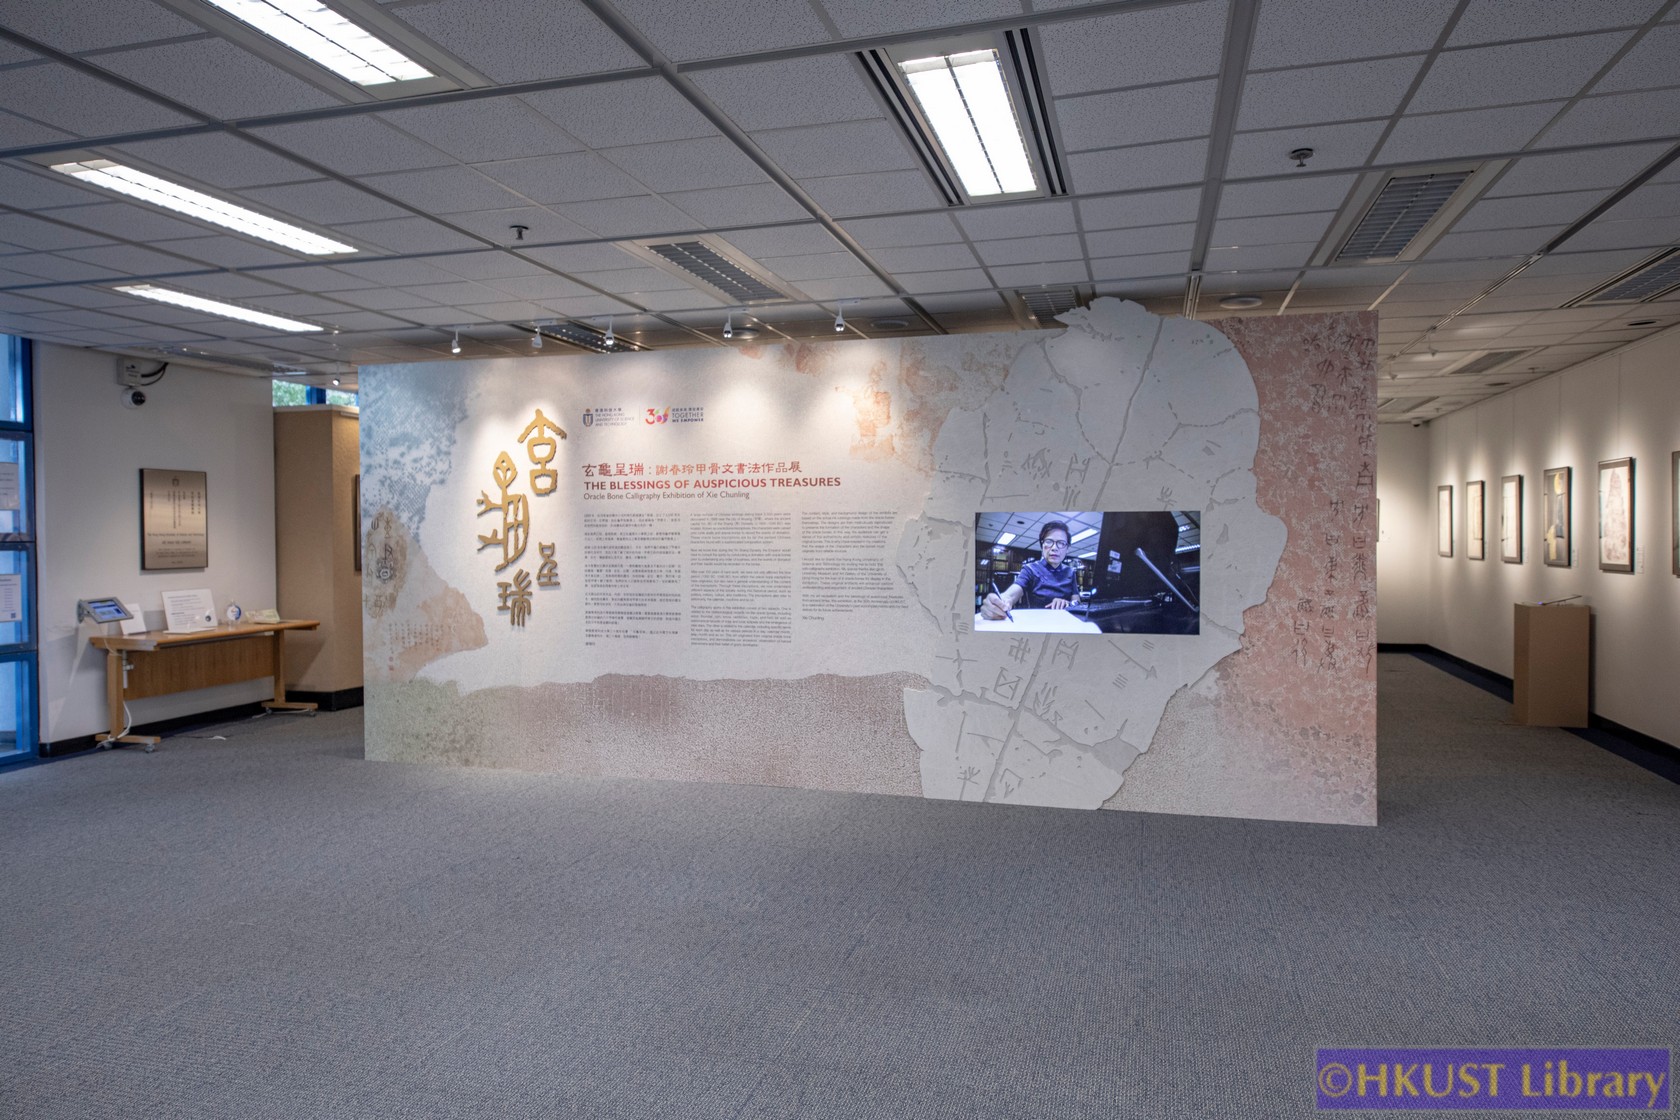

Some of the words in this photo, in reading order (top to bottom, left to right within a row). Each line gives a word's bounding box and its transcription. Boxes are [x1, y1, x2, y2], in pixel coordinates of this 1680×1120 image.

[584, 482, 607, 490] THE
[609, 481, 671, 490] BLESSINGS
[674, 480, 690, 489] OF
[694, 478, 767, 489] AUSPICIOUS
[770, 477, 841, 487] TREASURES
[607, 492, 623, 500] Bone
[625, 492, 660, 501] Calligraphy
[662, 491, 695, 499] Exhibition
[706, 490, 718, 499] Xie
[719, 490, 750, 500] Chunling
